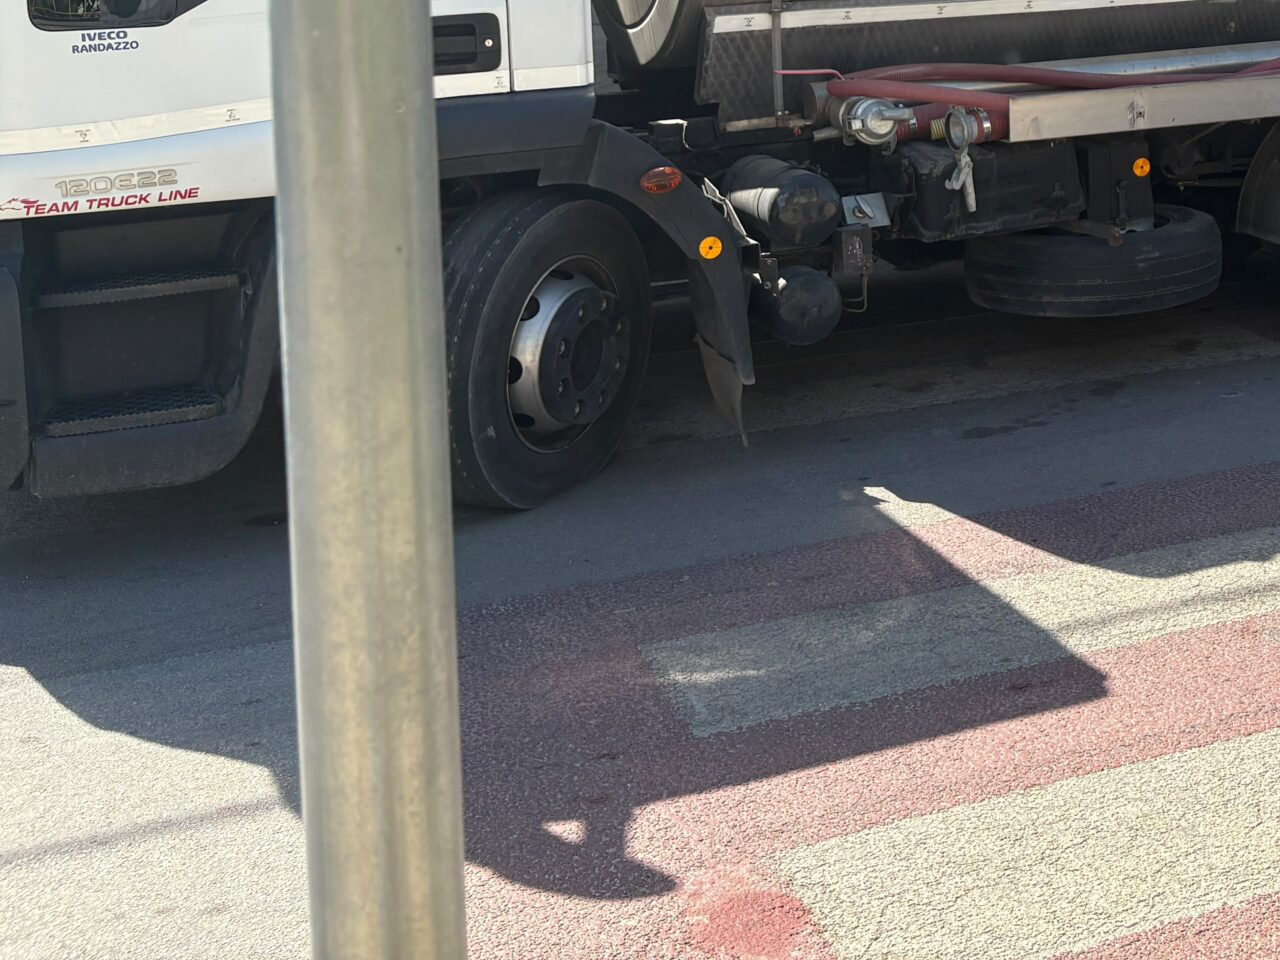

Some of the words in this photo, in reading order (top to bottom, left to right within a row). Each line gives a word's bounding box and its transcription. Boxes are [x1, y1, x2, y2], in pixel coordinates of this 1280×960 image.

[80, 30, 128, 42] IVECO
[71, 40, 140, 54] RANDAZZO
[54, 168, 178, 198] 120E22
[23, 199, 80, 216] TEAM
[86, 192, 152, 209] TRUCK
[157, 187, 200, 203] LINE
